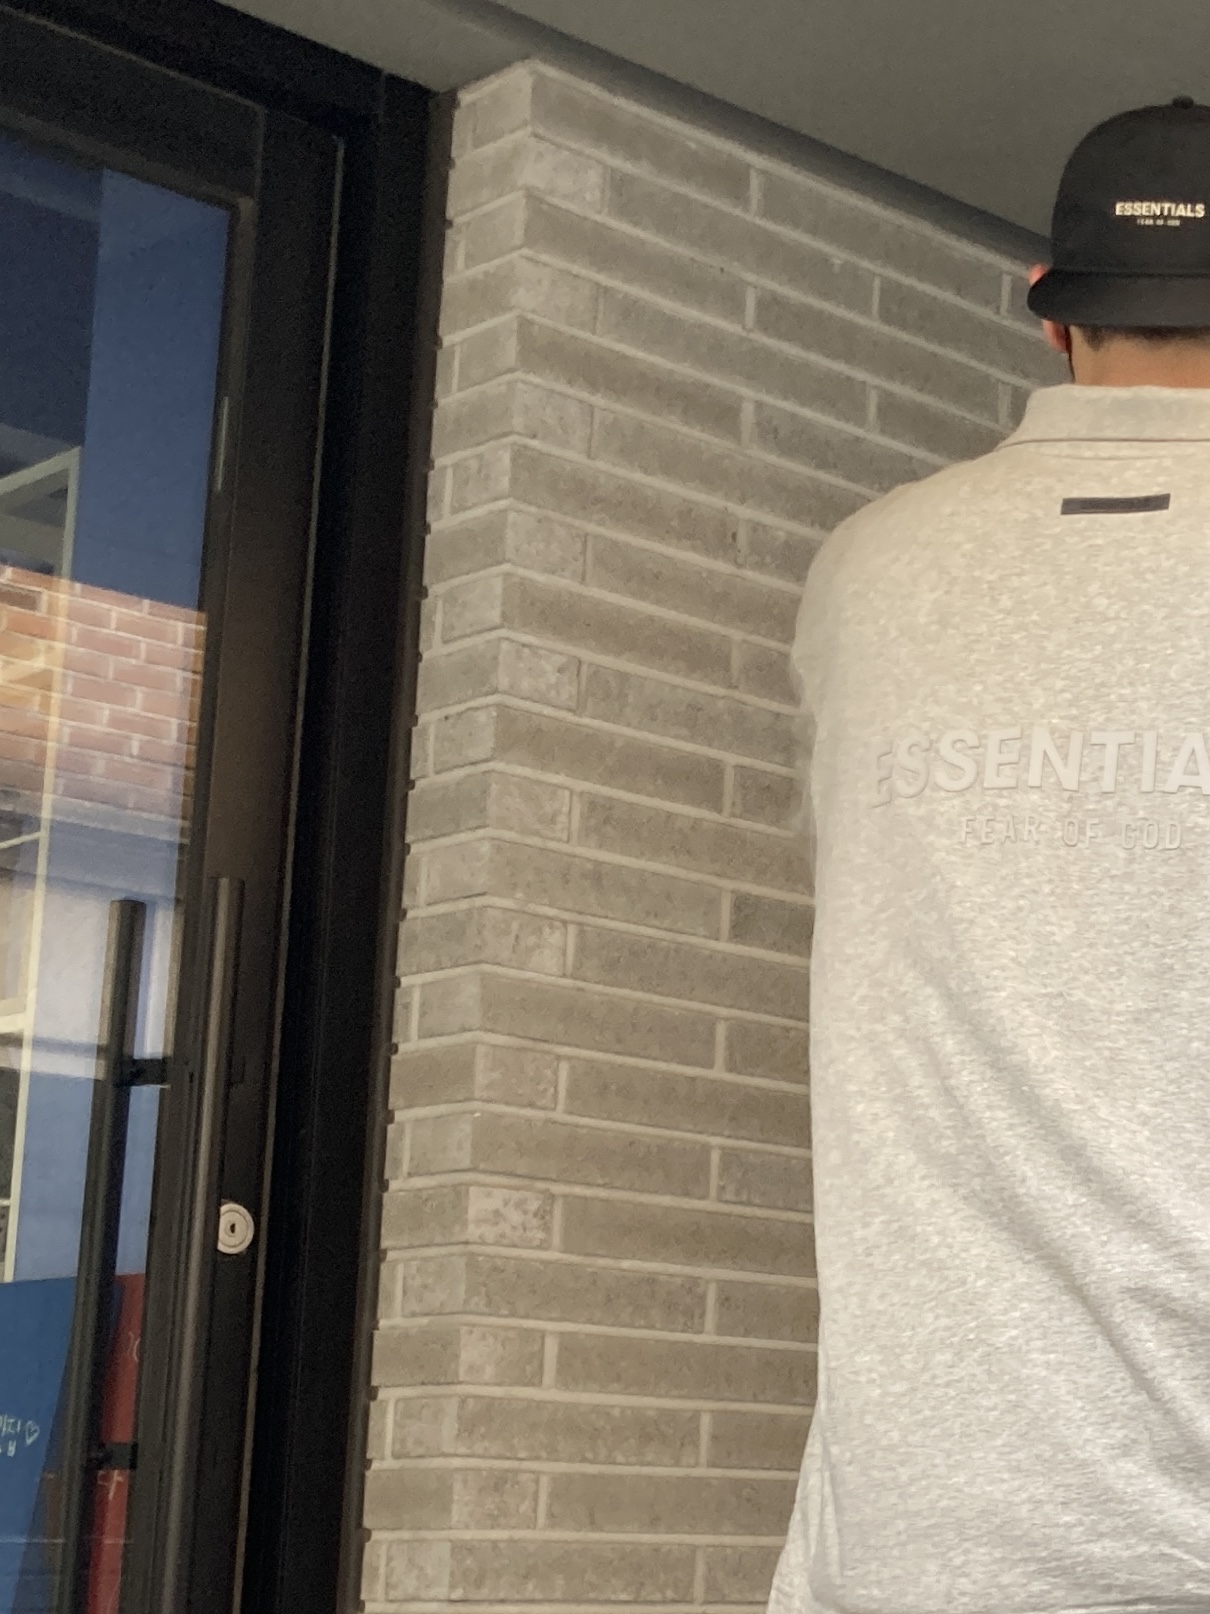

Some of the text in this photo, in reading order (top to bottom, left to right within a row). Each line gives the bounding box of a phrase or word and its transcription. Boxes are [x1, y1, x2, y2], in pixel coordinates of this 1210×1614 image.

[1115, 201, 1205, 218] ESSENTIALS
[960, 815, 1182, 851] FEAR OF GOD
